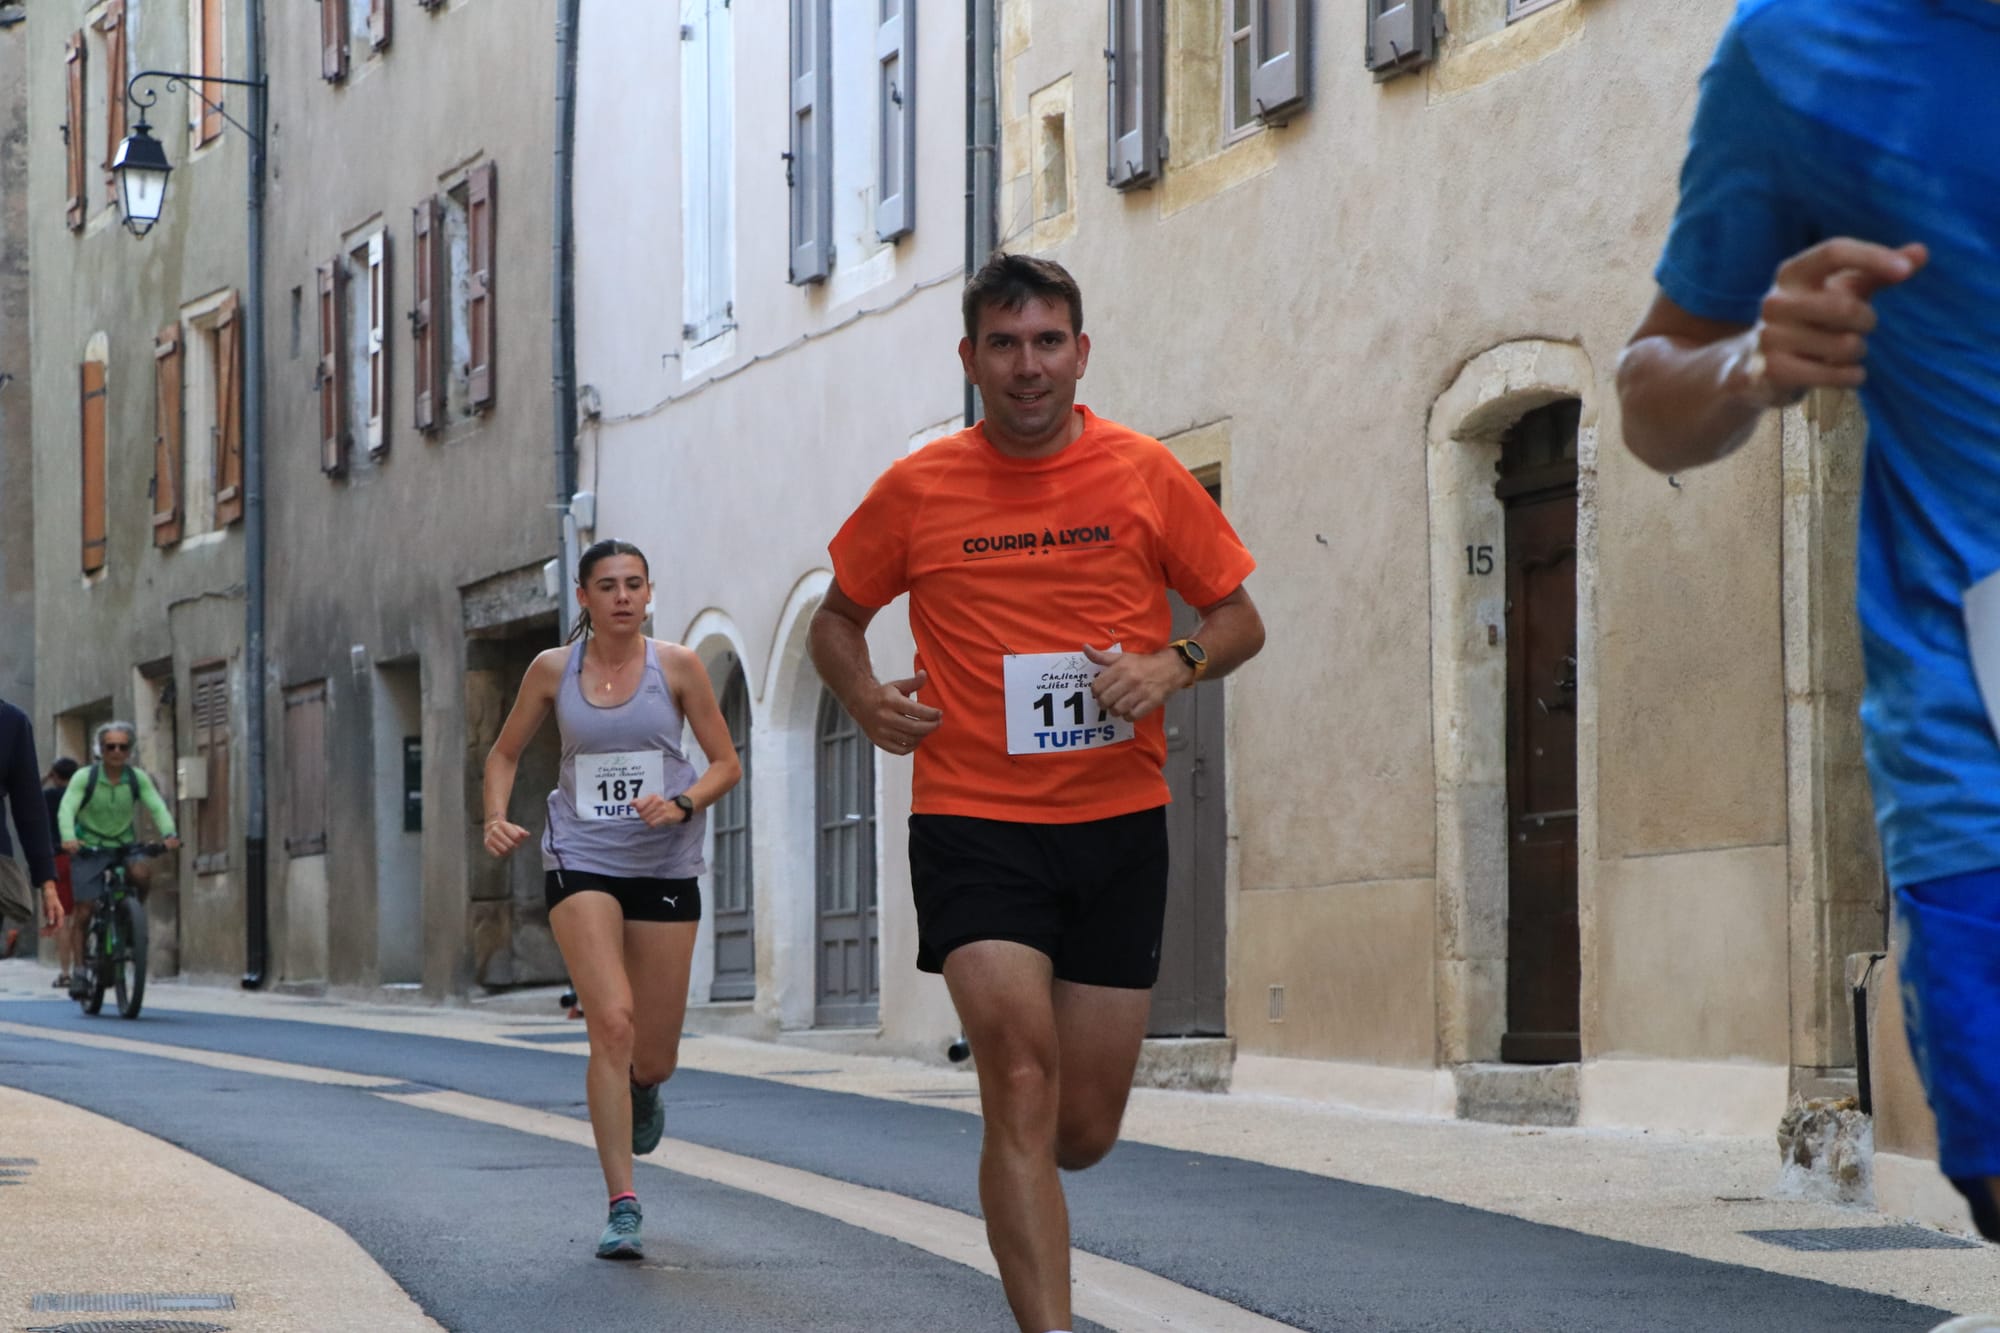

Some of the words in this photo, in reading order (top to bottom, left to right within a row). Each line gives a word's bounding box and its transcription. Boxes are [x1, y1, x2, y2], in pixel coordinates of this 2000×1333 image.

[963, 532, 1037, 554] COURIR
[1041, 528, 1056, 547] À
[1059, 525, 1110, 545] LYON
[1466, 545, 1494, 576] 15
[1041, 672, 1088, 682] Challenge
[1034, 725, 1115, 748] TUFF'S
[597, 779, 643, 801] 187
[594, 804, 635, 816] TUFF
